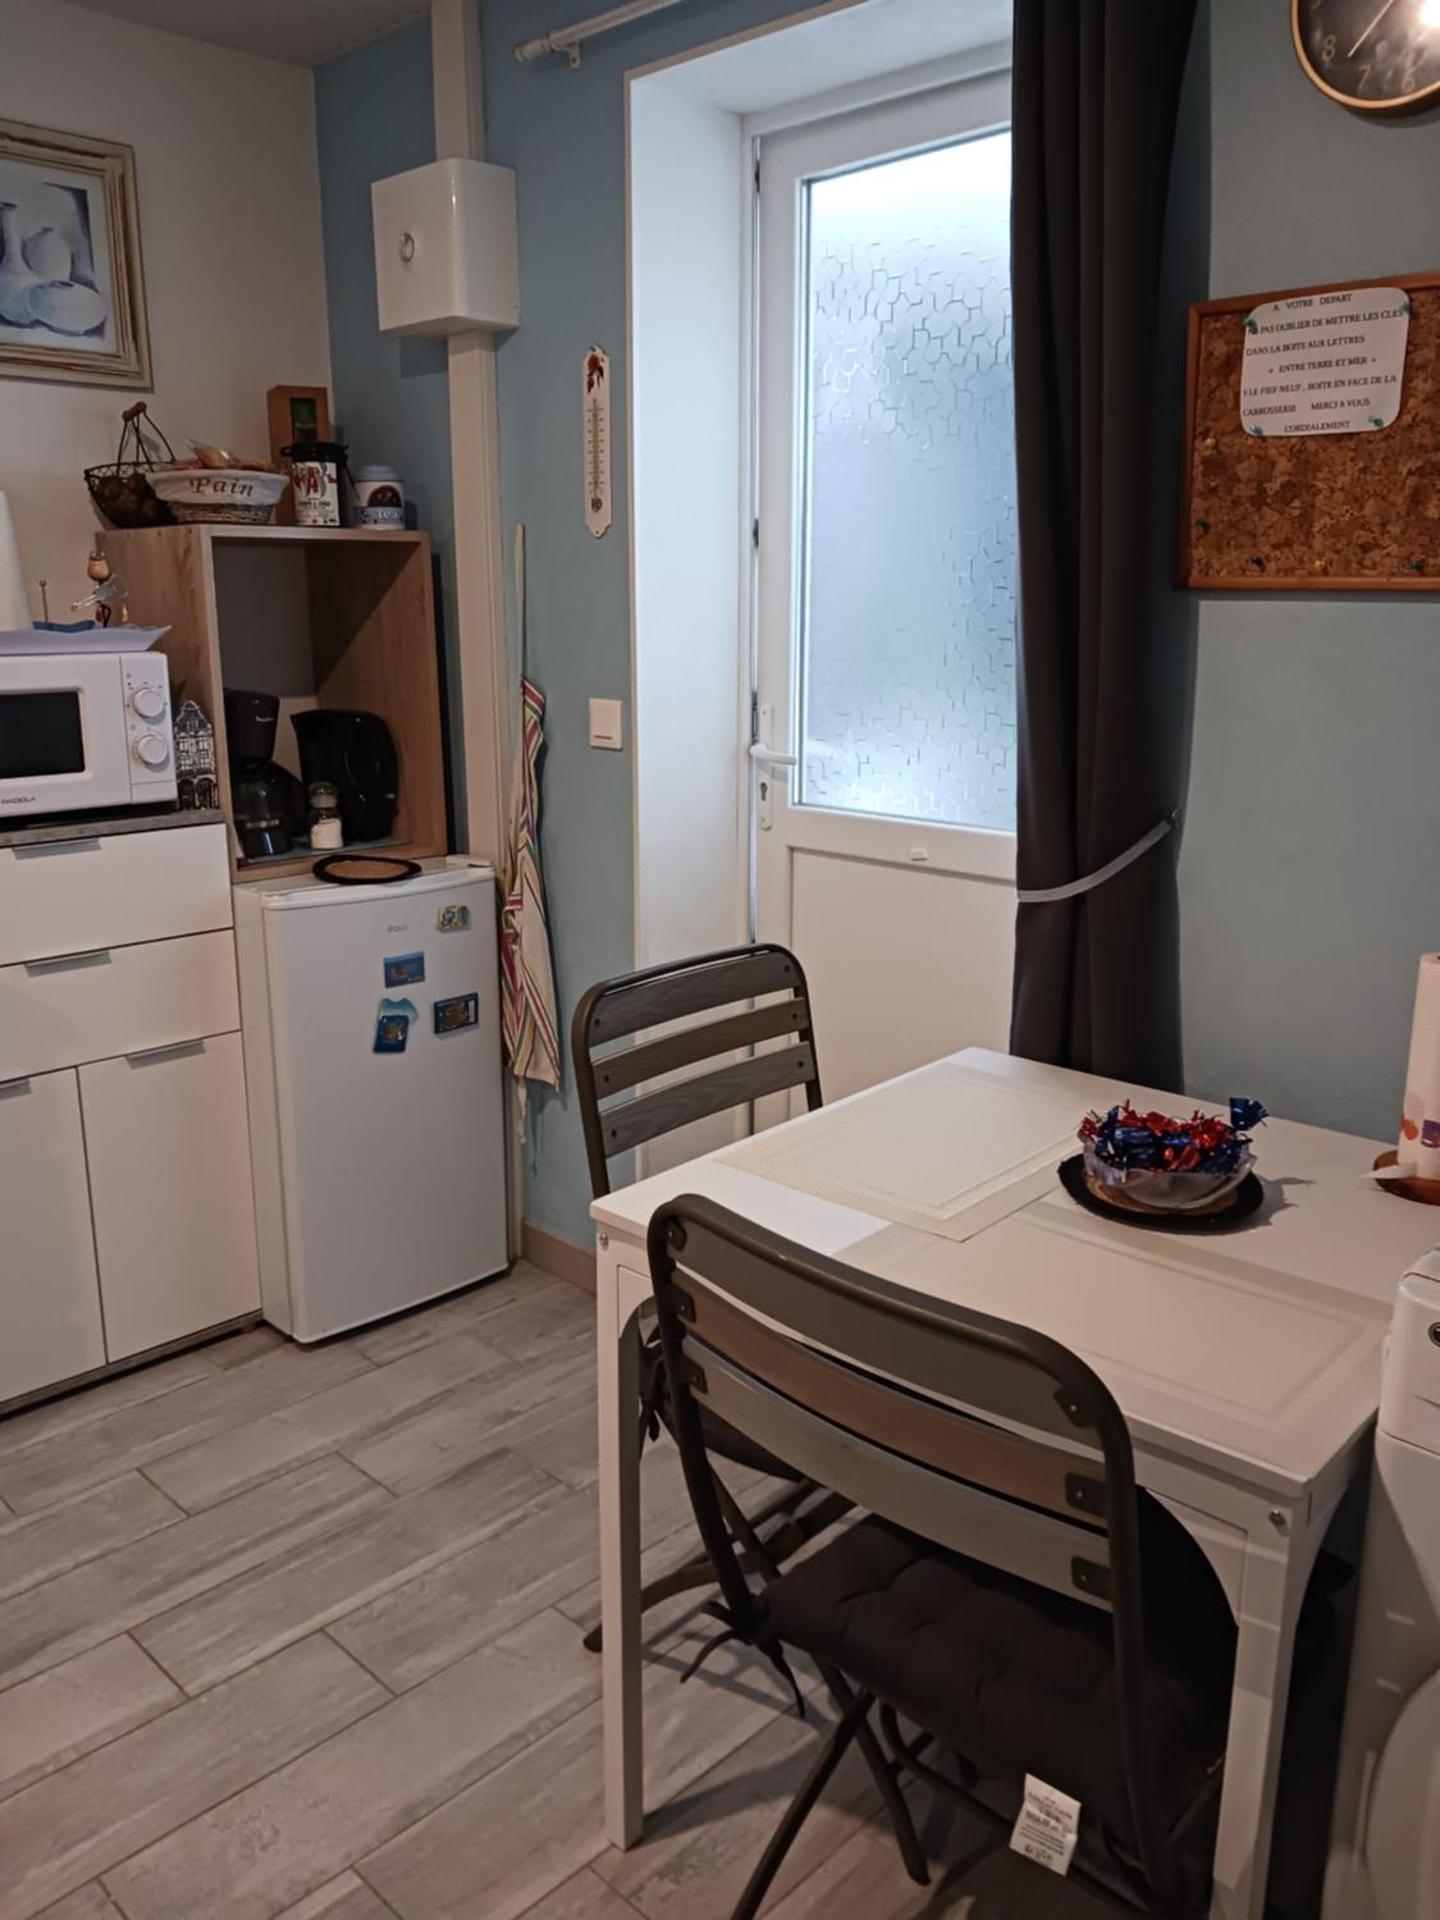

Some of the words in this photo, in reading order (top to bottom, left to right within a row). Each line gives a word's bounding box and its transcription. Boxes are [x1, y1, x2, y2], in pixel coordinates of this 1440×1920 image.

[1321, 34, 1337, 61] 8
[1357, 64, 1372, 94] 7
[1286, 299, 1313, 309] VOTRE
[1319, 294, 1352, 305] DEPART
[1260, 325, 1274, 334] PAS
[1276, 321, 1311, 332] OUBLIER
[1312, 319, 1323, 328] DE
[1325, 313, 1361, 325] METTRE
[1362, 311, 1379, 321] LES
[1246, 347, 1268, 356] DANS
[1270, 345, 1281, 354] LA
[1307, 339, 1325, 349] AUX
[1327, 335, 1366, 347] LETTRES
[1279, 362, 1305, 373] ENTRE
[1307, 360, 1332, 370] TERRE
[1335, 358, 1346, 367] ET
[1347, 356, 1367, 366] MER
[1249, 388, 1258, 396] LE
[1334, 379, 1346, 388] EN
[1347, 377, 1369, 387] FACE
[1371, 376, 1382, 385] DE
[1384, 374, 1397, 384] LA
[1310, 400, 1338, 411] MERCI
[1347, 398, 1370, 408] VOUS
[1283, 420, 1351, 433] CORDIALEMENT
[190, 476, 253, 498] Pain
